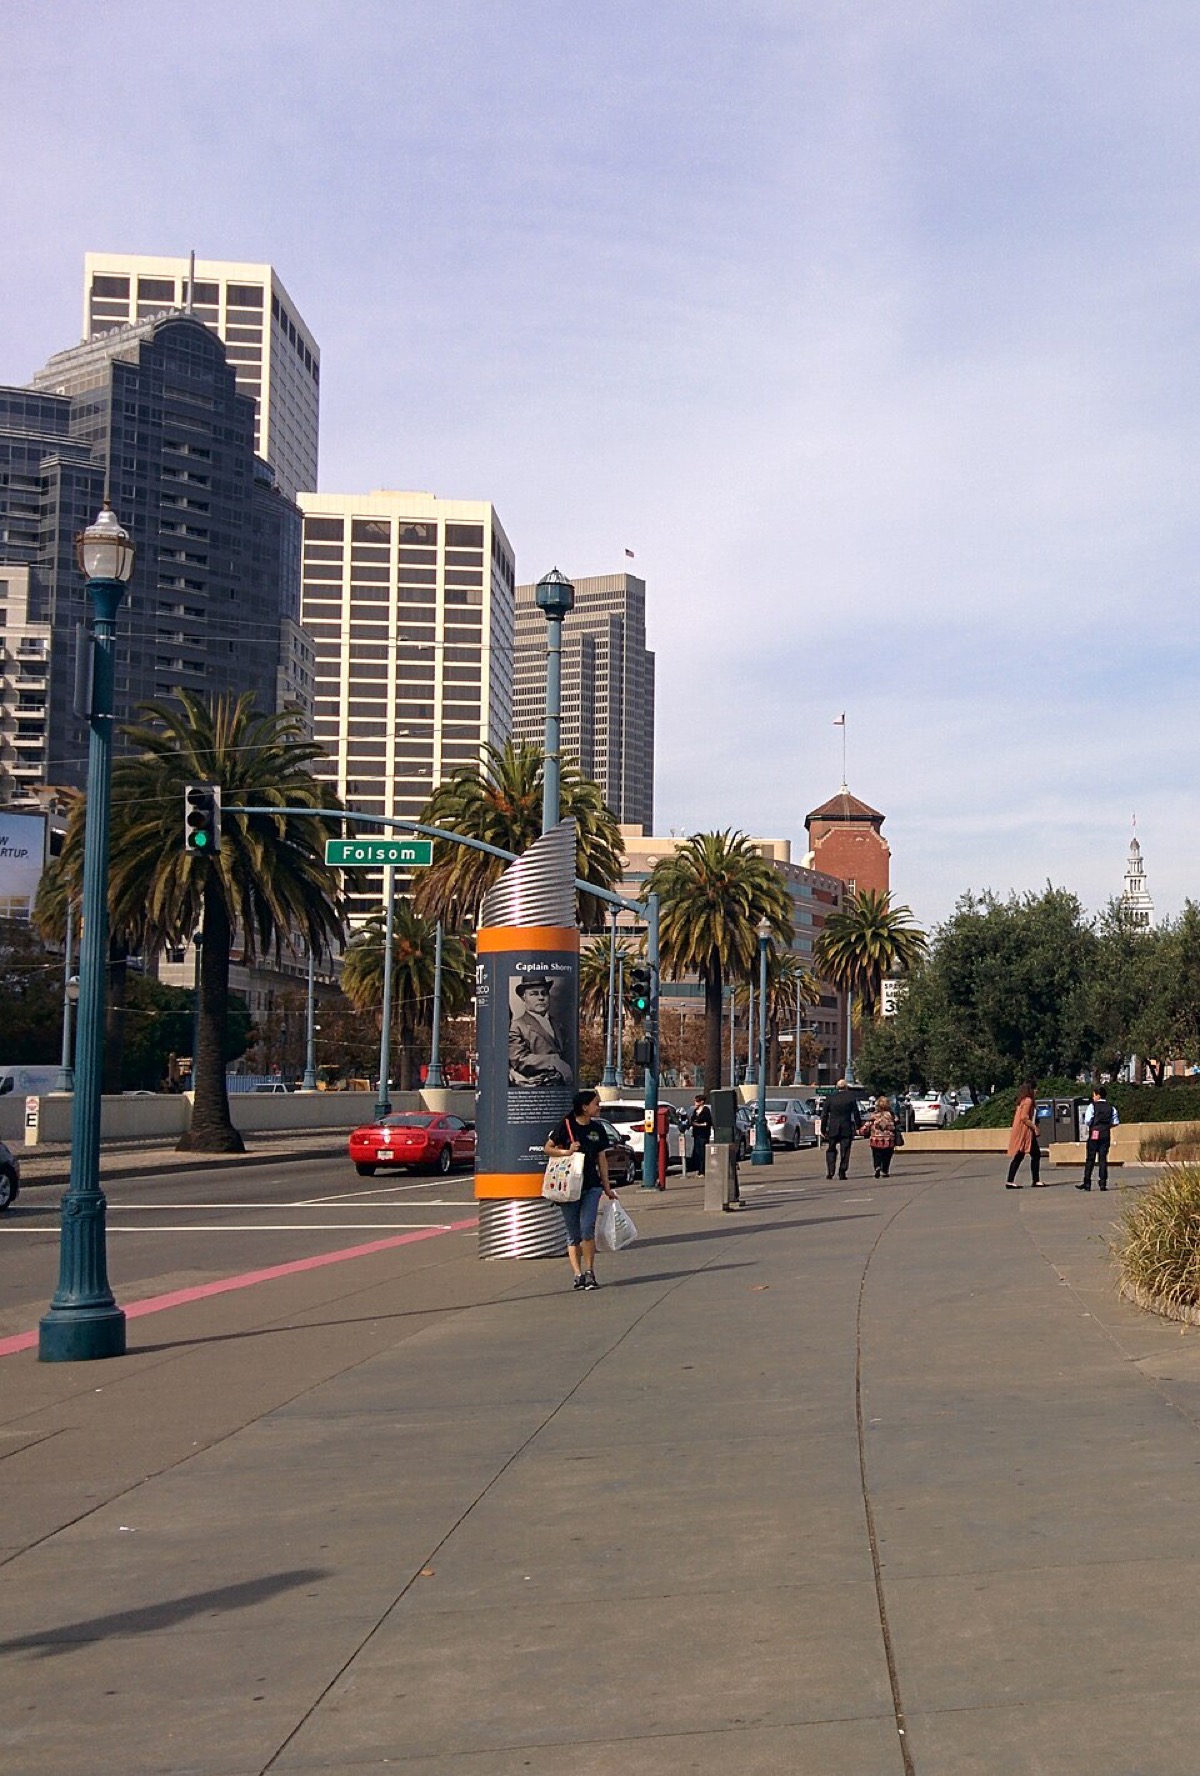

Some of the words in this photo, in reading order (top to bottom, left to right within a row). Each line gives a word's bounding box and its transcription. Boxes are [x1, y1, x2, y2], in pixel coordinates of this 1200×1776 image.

[0, 848, 29, 858] RTUP.
[343, 846, 415, 860] Folsom
[515, 962, 549, 973] Captain
[550, 963, 572, 973] Shorey
[884, 999, 898, 1013] 3
[26, 1113, 37, 1127] E
